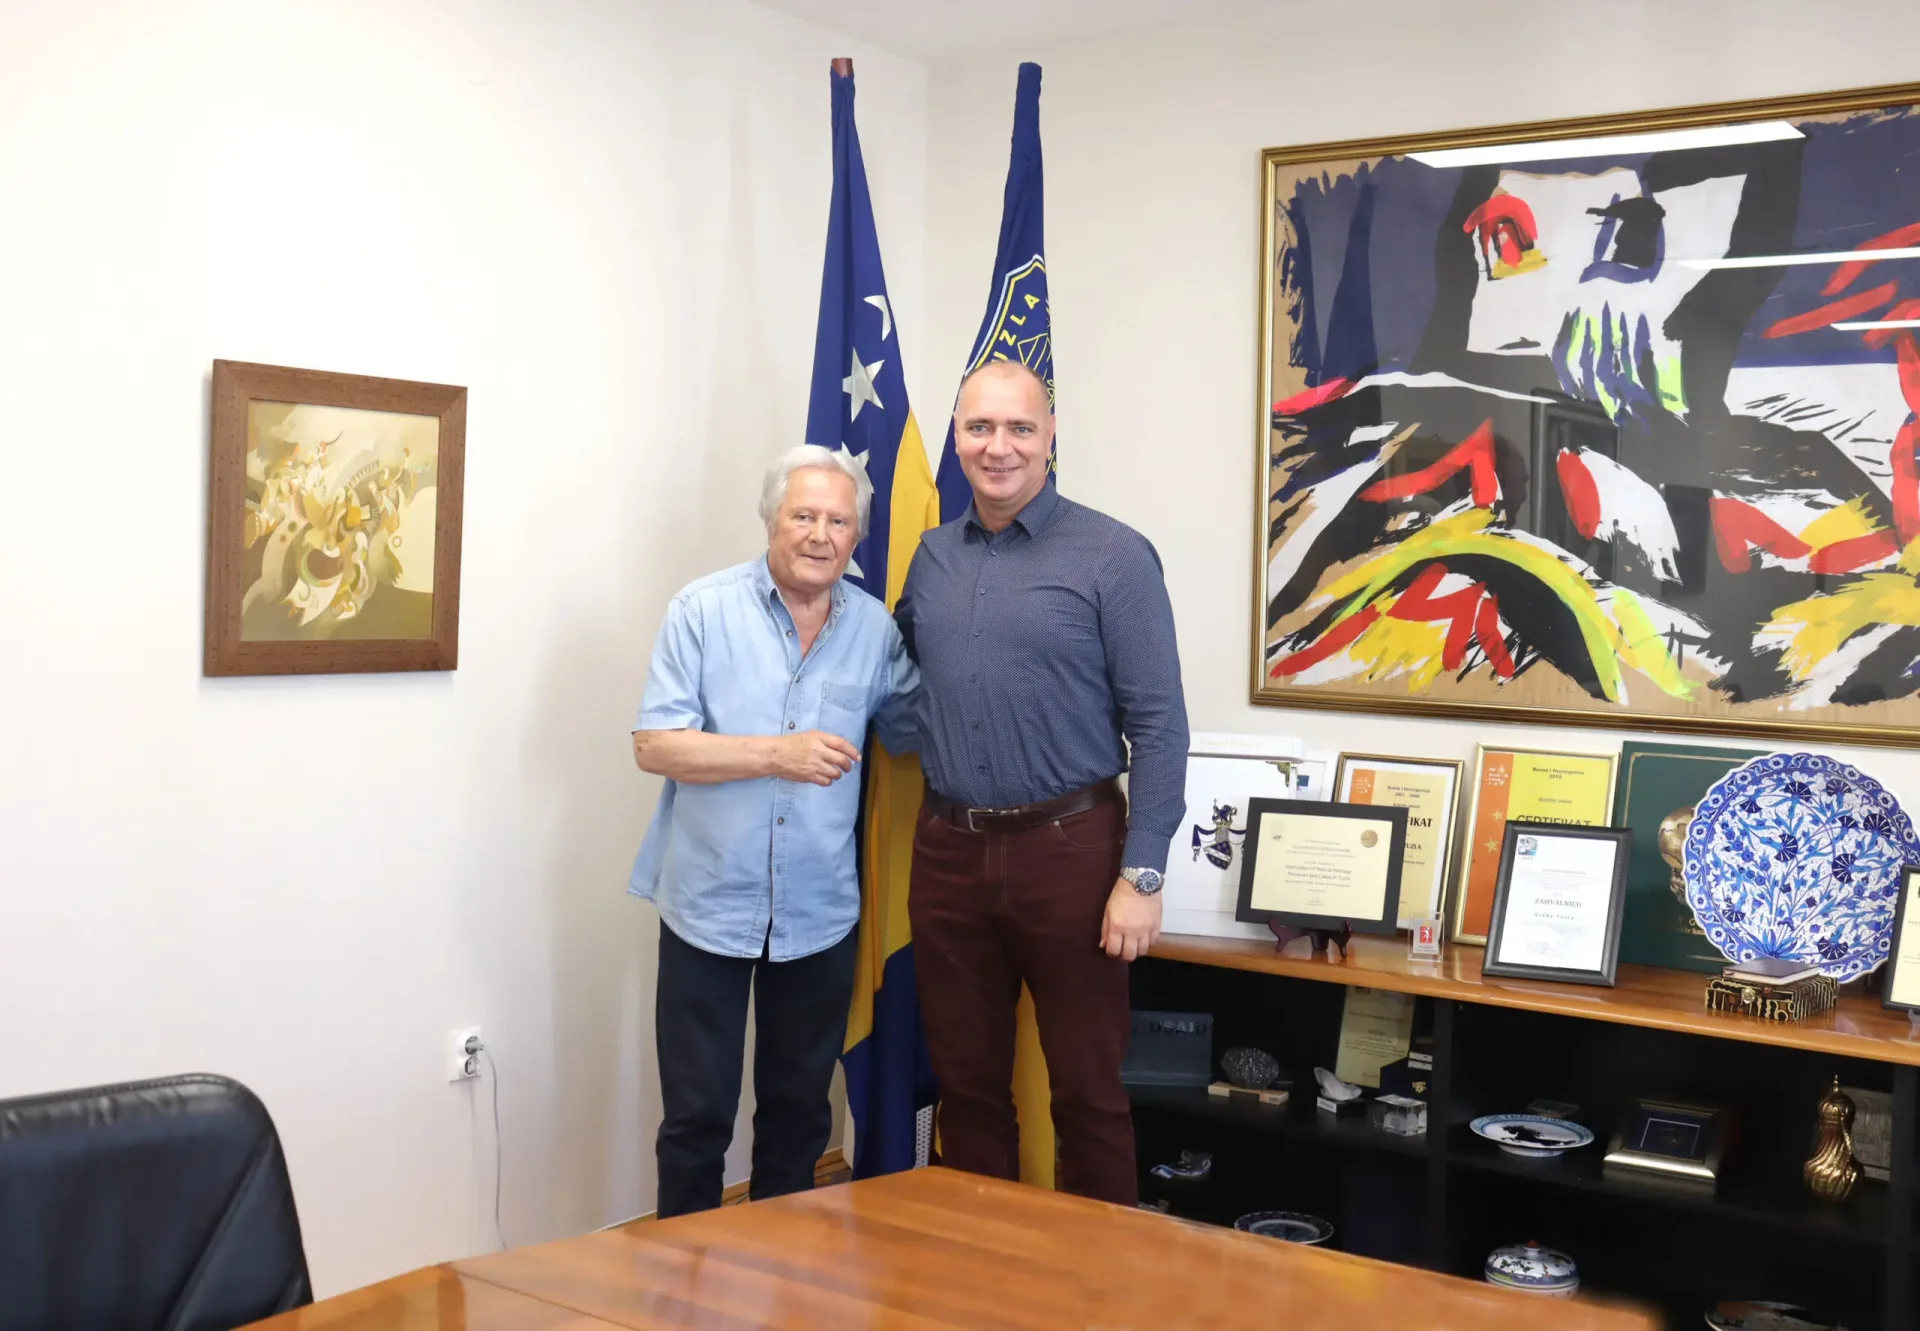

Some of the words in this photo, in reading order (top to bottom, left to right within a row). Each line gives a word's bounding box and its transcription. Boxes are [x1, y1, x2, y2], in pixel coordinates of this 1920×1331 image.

[990, 293, 1041, 364] UZLA
[1534, 898, 1582, 908] ZAHVALNICU
[1149, 1019, 1208, 1037] USAID
